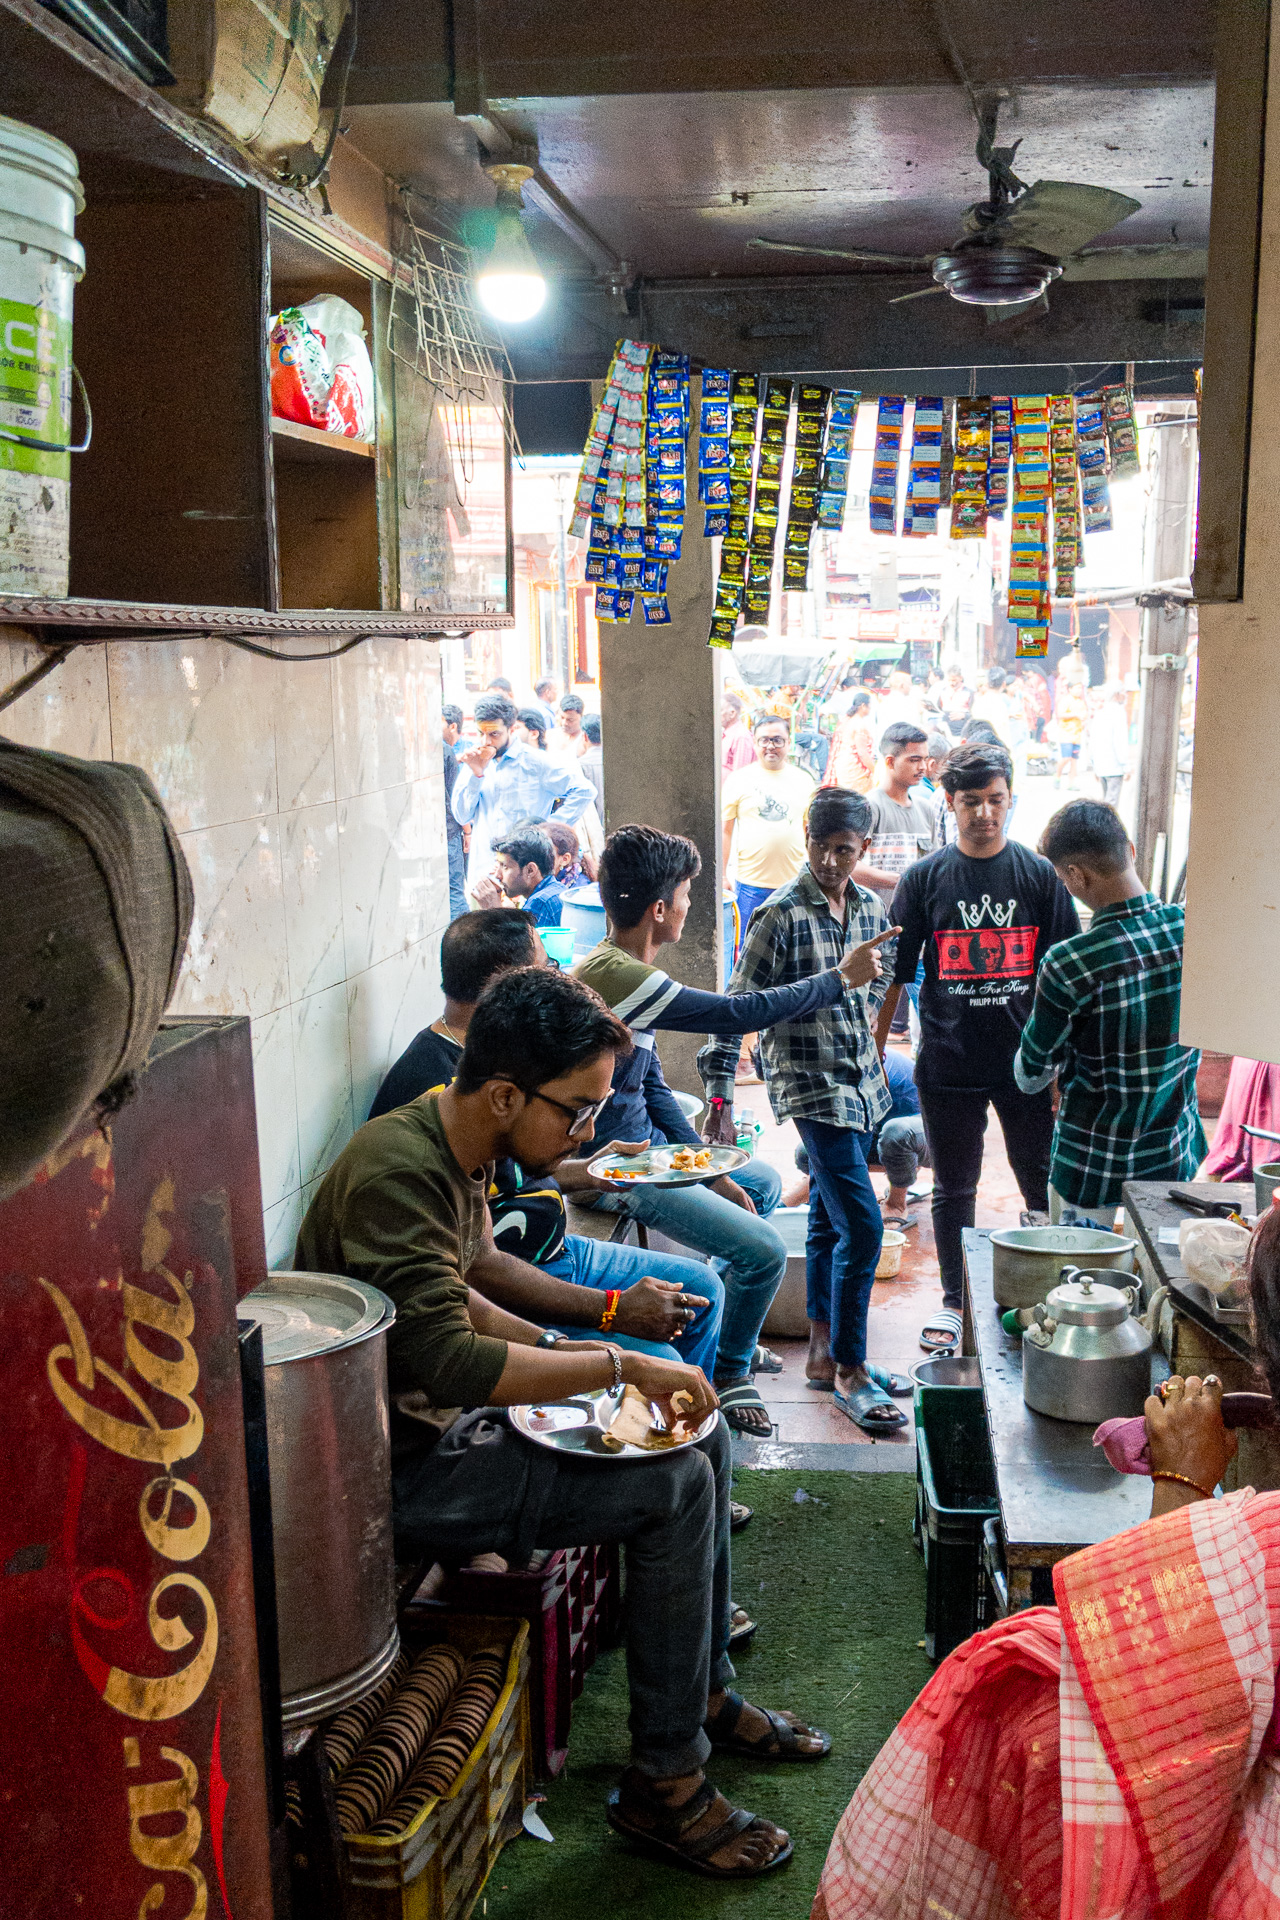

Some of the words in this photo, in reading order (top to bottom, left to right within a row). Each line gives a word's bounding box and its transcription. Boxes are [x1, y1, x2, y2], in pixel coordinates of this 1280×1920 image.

[0, 320, 57, 363] CE
[661, 451, 680, 462] CASH
[947, 982, 976, 995] Made
[979, 981, 1001, 995] For
[1002, 979, 1029, 996] Kings
[969, 997, 991, 1007] PHILIPP
